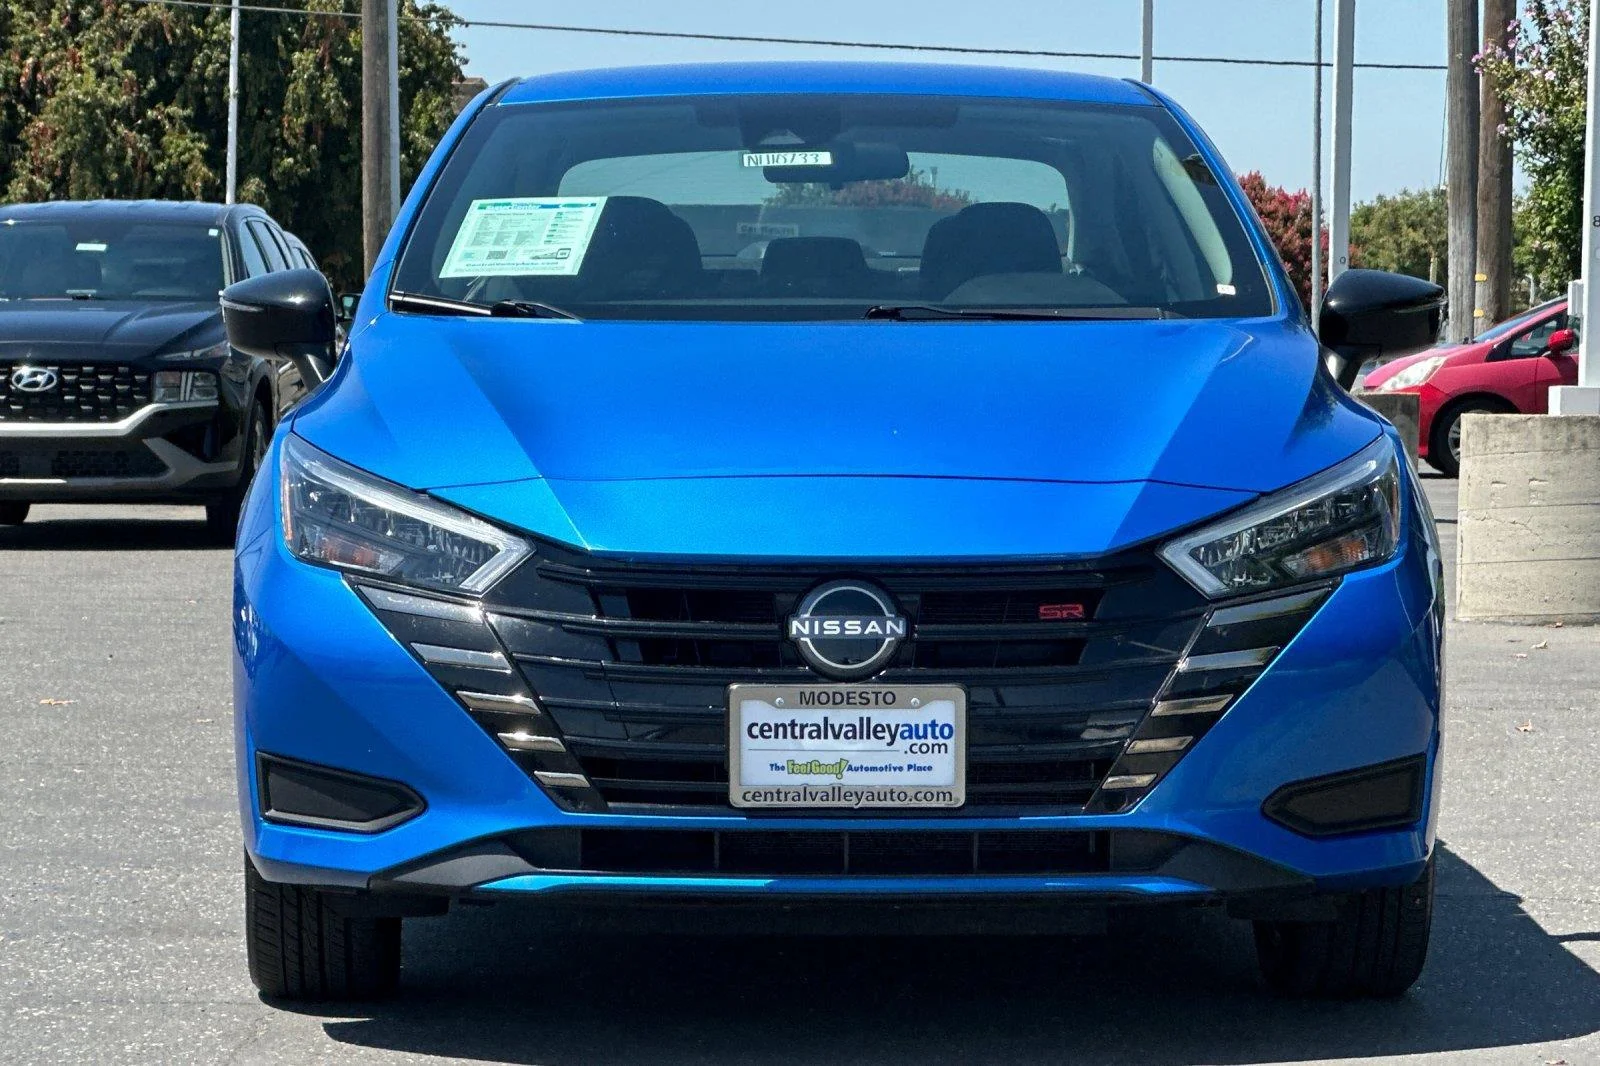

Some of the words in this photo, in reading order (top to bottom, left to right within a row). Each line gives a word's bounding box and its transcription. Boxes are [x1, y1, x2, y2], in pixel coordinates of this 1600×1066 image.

[1039, 604, 1084, 619] SR
[791, 620, 903, 635] NISSAN
[799, 691, 896, 706] MODESTO
[747, 716, 954, 746] centralvalleyauto
[904, 742, 948, 754] .com
[769, 763, 785, 772] The
[847, 763, 903, 773] Automotive
[907, 763, 933, 772] Place
[742, 786, 953, 806] centralvalleyauto.com
